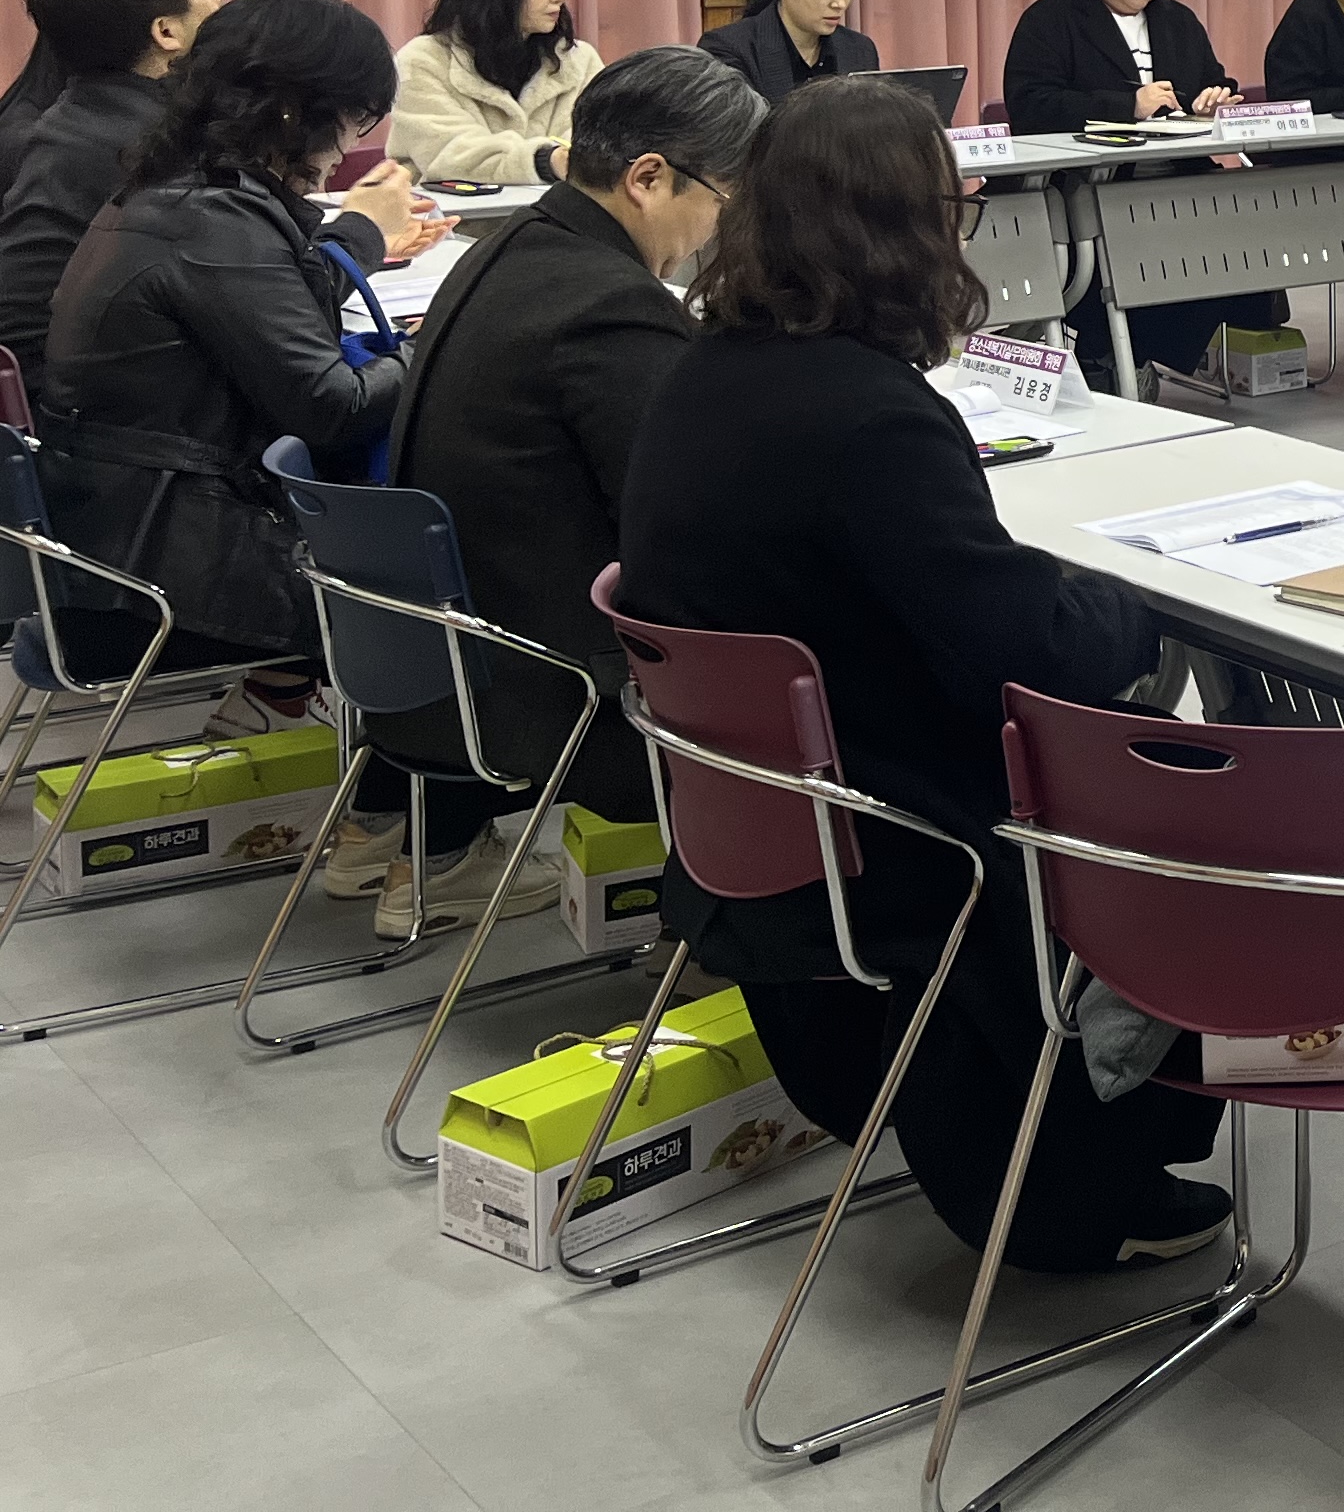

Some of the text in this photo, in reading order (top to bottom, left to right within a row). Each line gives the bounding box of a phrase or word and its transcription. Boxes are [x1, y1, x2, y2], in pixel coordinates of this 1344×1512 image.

[1013, 376, 1052, 402] 김윤경
[143, 827, 200, 849] 하루견과
[624, 1137, 682, 1176] 하루견과
